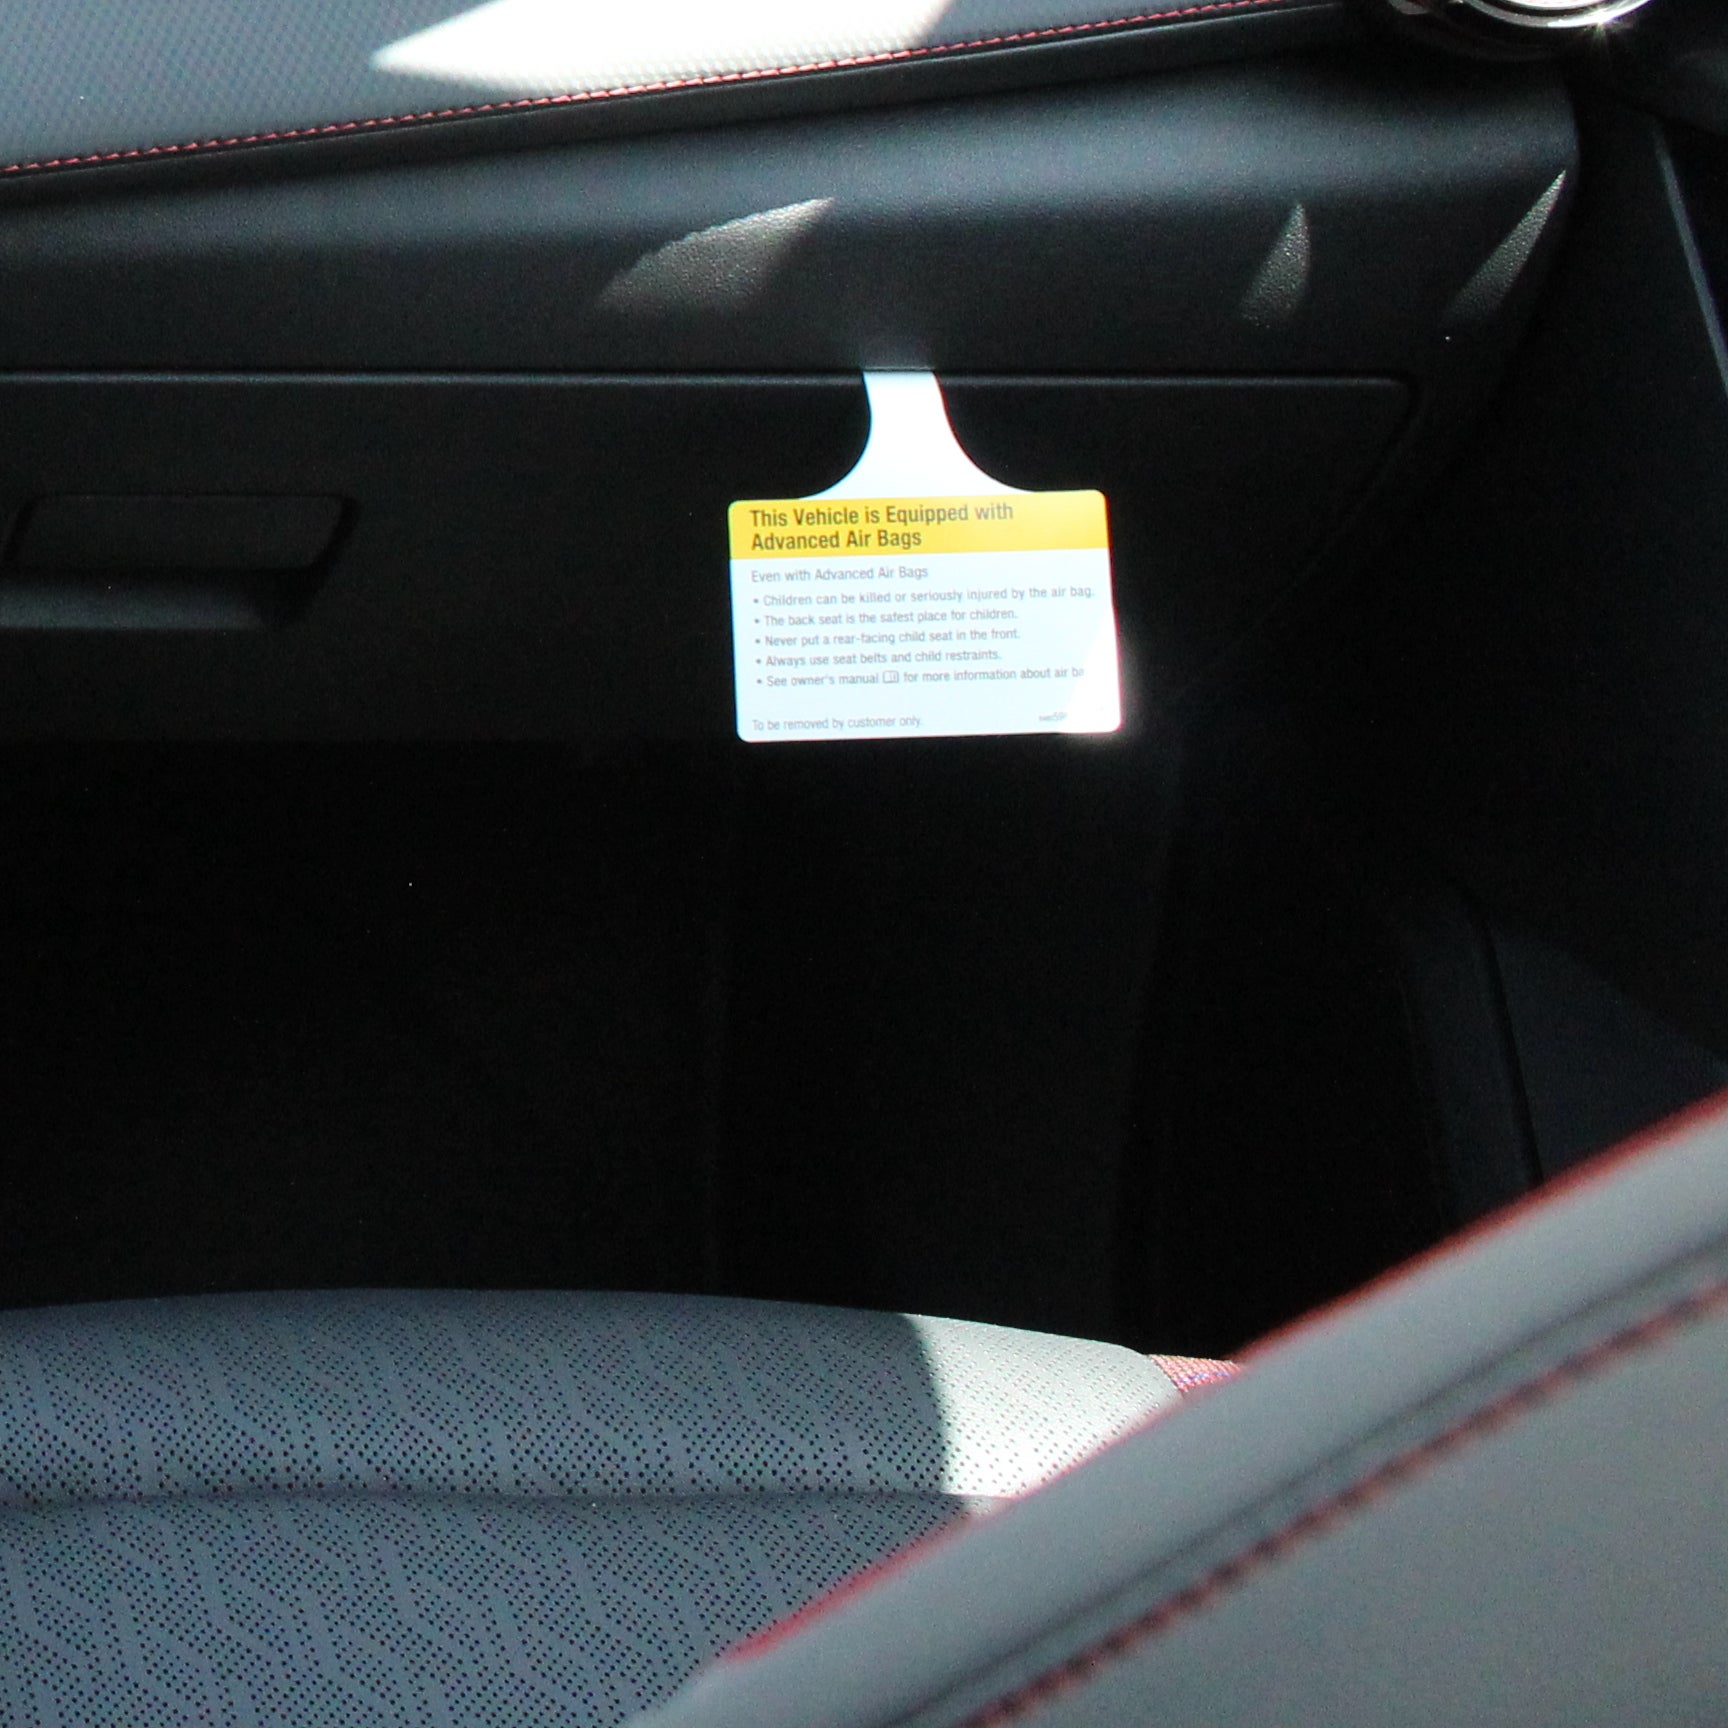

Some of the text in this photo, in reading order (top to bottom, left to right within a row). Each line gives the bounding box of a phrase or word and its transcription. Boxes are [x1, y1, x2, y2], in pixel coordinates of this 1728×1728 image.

[749, 503, 1014, 527] This Vehicle is Equipped with
[751, 528, 923, 551] Advanced Air Bags
